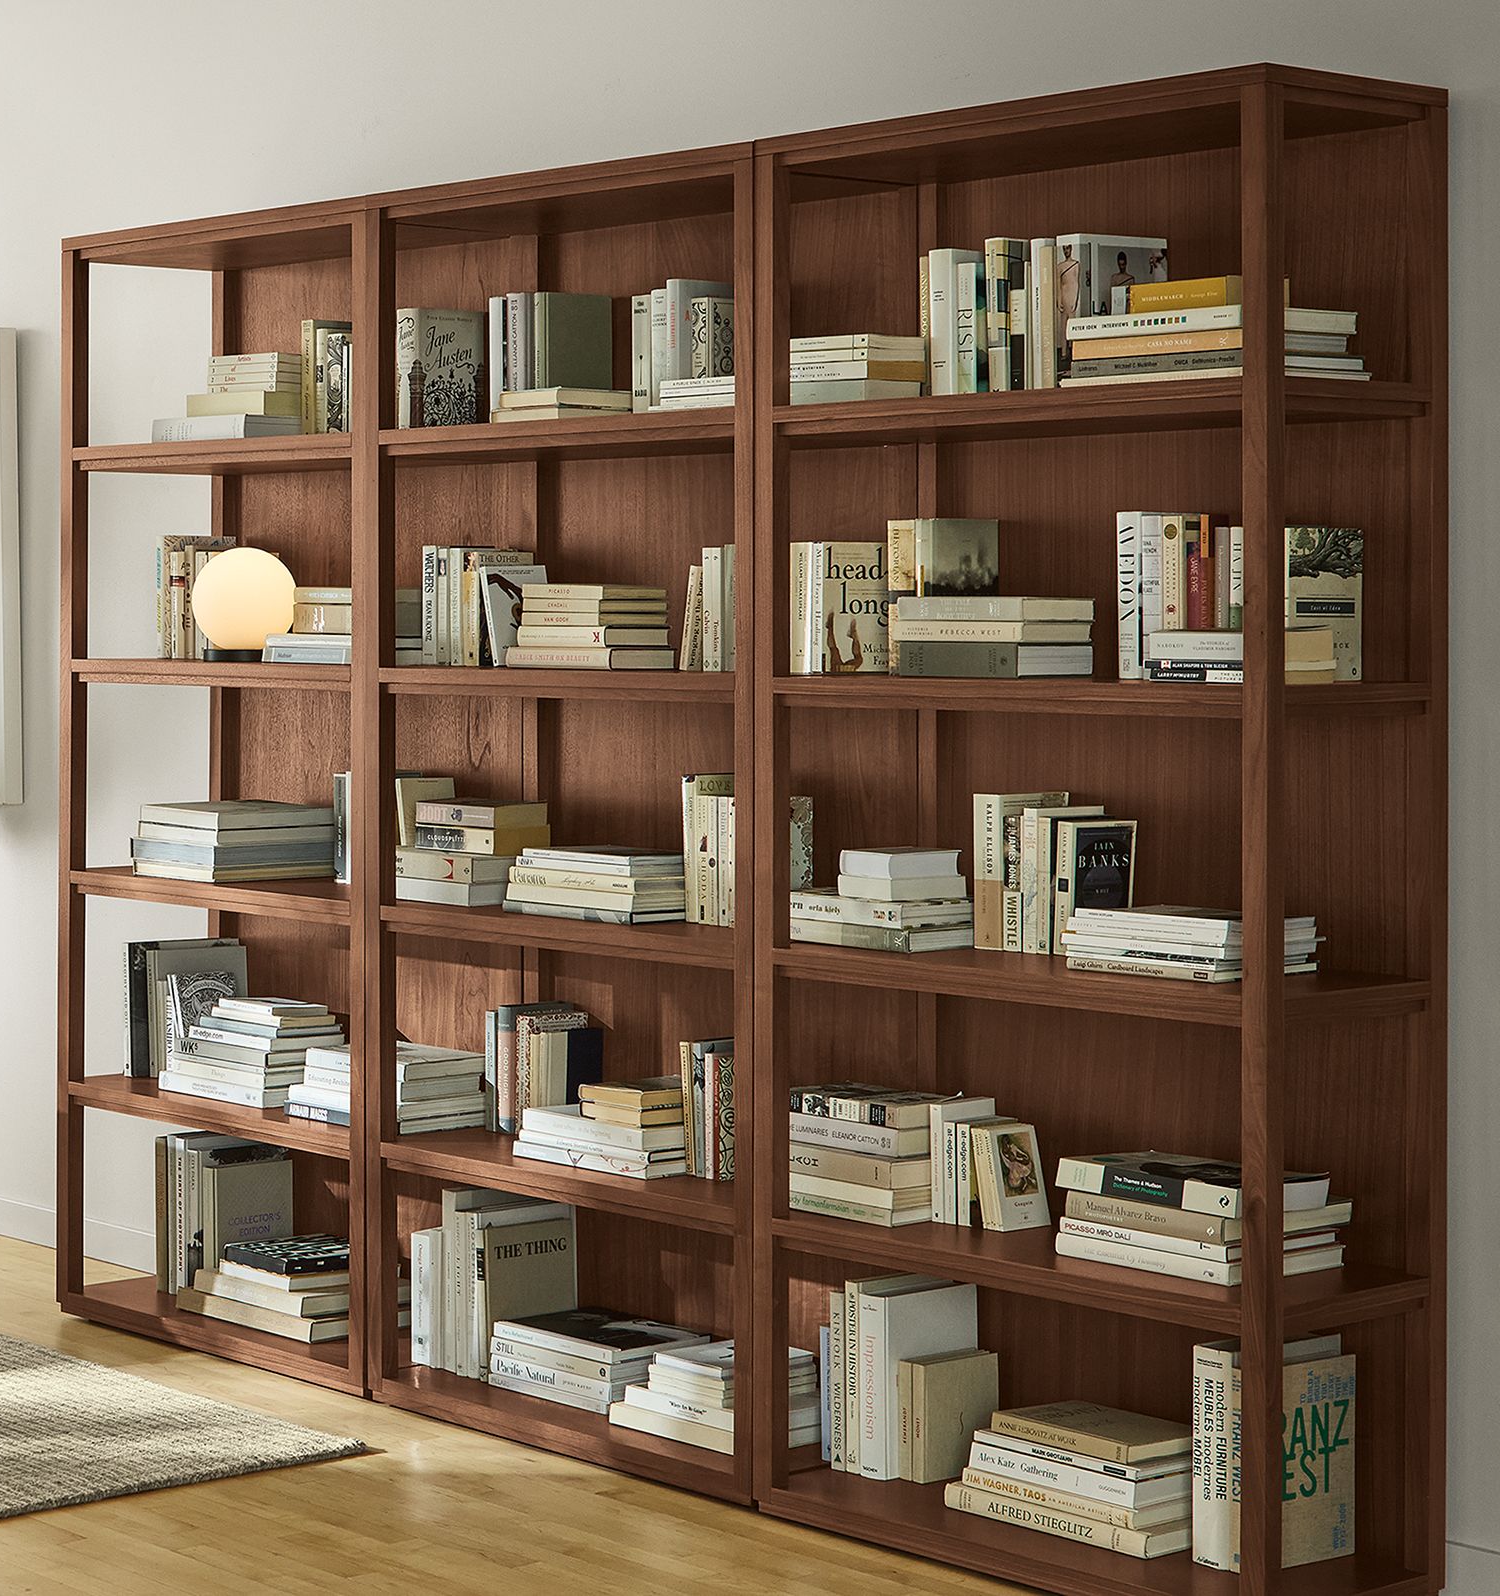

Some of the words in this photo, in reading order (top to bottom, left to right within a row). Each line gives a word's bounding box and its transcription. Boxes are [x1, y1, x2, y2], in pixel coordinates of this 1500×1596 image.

[1142, 293, 1184, 302] MIDDLEMARCH
[957, 308, 973, 362] RISE
[1072, 323, 1087, 331] PETER
[1101, 321, 1129, 329] INTERVIEWS
[426, 326, 456, 356] Jane
[425, 346, 475, 374] Austen
[479, 554, 494, 562] THE
[496, 554, 520, 562] OTHER
[1232, 542, 1242, 562] HA
[424, 552, 434, 594] WATCHERS
[1190, 558, 1198, 575] JANE
[1190, 576, 1198, 594] EYRE
[1232, 569, 1242, 591] JIN
[839, 581, 890, 627] long
[813, 610, 822, 646] Headlong
[863, 644, 889, 653] Micha
[1008, 836, 1017, 861] JAMES
[1094, 842, 1114, 850] IAIN
[1078, 853, 1129, 868] BANKS
[1009, 864, 1017, 889] JONES
[1007, 896, 1017, 946] WHISTLE
[1073, 960, 1087, 969] Luigi
[1107, 962, 1134, 972] Cardboard
[1135, 965, 1164, 976] Landscapes
[193, 1029, 224, 1040] at-edge.com
[796, 1126, 828, 1137] LUMINARIES
[832, 1130, 857, 1141] ELEANOR
[857, 1135, 879, 1145] CATTON
[1113, 1182, 1135, 1192] Dictionary
[1141, 1187, 1168, 1198] Photography
[1145, 1180, 1162, 1189] Hudson
[178, 1201, 182, 1210] OF
[228, 1210, 282, 1226] COLLECTOR'S
[1085, 1200, 1112, 1214] Manuel
[1144, 1210, 1167, 1224] Bravo
[239, 1225, 271, 1236] EDITION
[1065, 1223, 1095, 1235] PICASSO
[494, 1244, 522, 1260] THE
[525, 1237, 567, 1255] THING
[849, 1300, 857, 1336] POSTER
[496, 1341, 515, 1355] STILL
[849, 1339, 857, 1349] IN
[496, 1359, 524, 1377] Pacific
[525, 1366, 556, 1386] Natural
[849, 1353, 857, 1398] HISTORY
[864, 1335, 877, 1439] Impressionism
[834, 1383, 842, 1450] WILDERNESS
[1194, 1376, 1202, 1434] moderne
[1204, 1379, 1214, 1432] MEUBLES
[1216, 1381, 1227, 1432] modern
[999, 1421, 1017, 1431] ANNIE
[1057, 1434, 1077, 1446] WORK
[1032, 1448, 1046, 1457] MARK
[1194, 1438, 1203, 1478] MÖBEL
[977, 1452, 996, 1466] Alex
[997, 1455, 1015, 1469] Katz
[1020, 1458, 1058, 1481] Gathering
[1204, 1436, 1213, 1500] modernes
[1216, 1437, 1227, 1500] FURNITURE
[1282, 1444, 1336, 1502] EST
[966, 1474, 981, 1485] JIM
[983, 1478, 1021, 1496] WAGNER,
[1023, 1489, 1046, 1501] TAOS
[1058, 1500, 1085, 1511] AMERICAN
[1087, 1506, 1106, 1516] ARTIST
[1232, 1466, 1241, 1503] WEST
[988, 1502, 1032, 1521] ALFRED
[1034, 1512, 1093, 1539] STIEGLITZ
